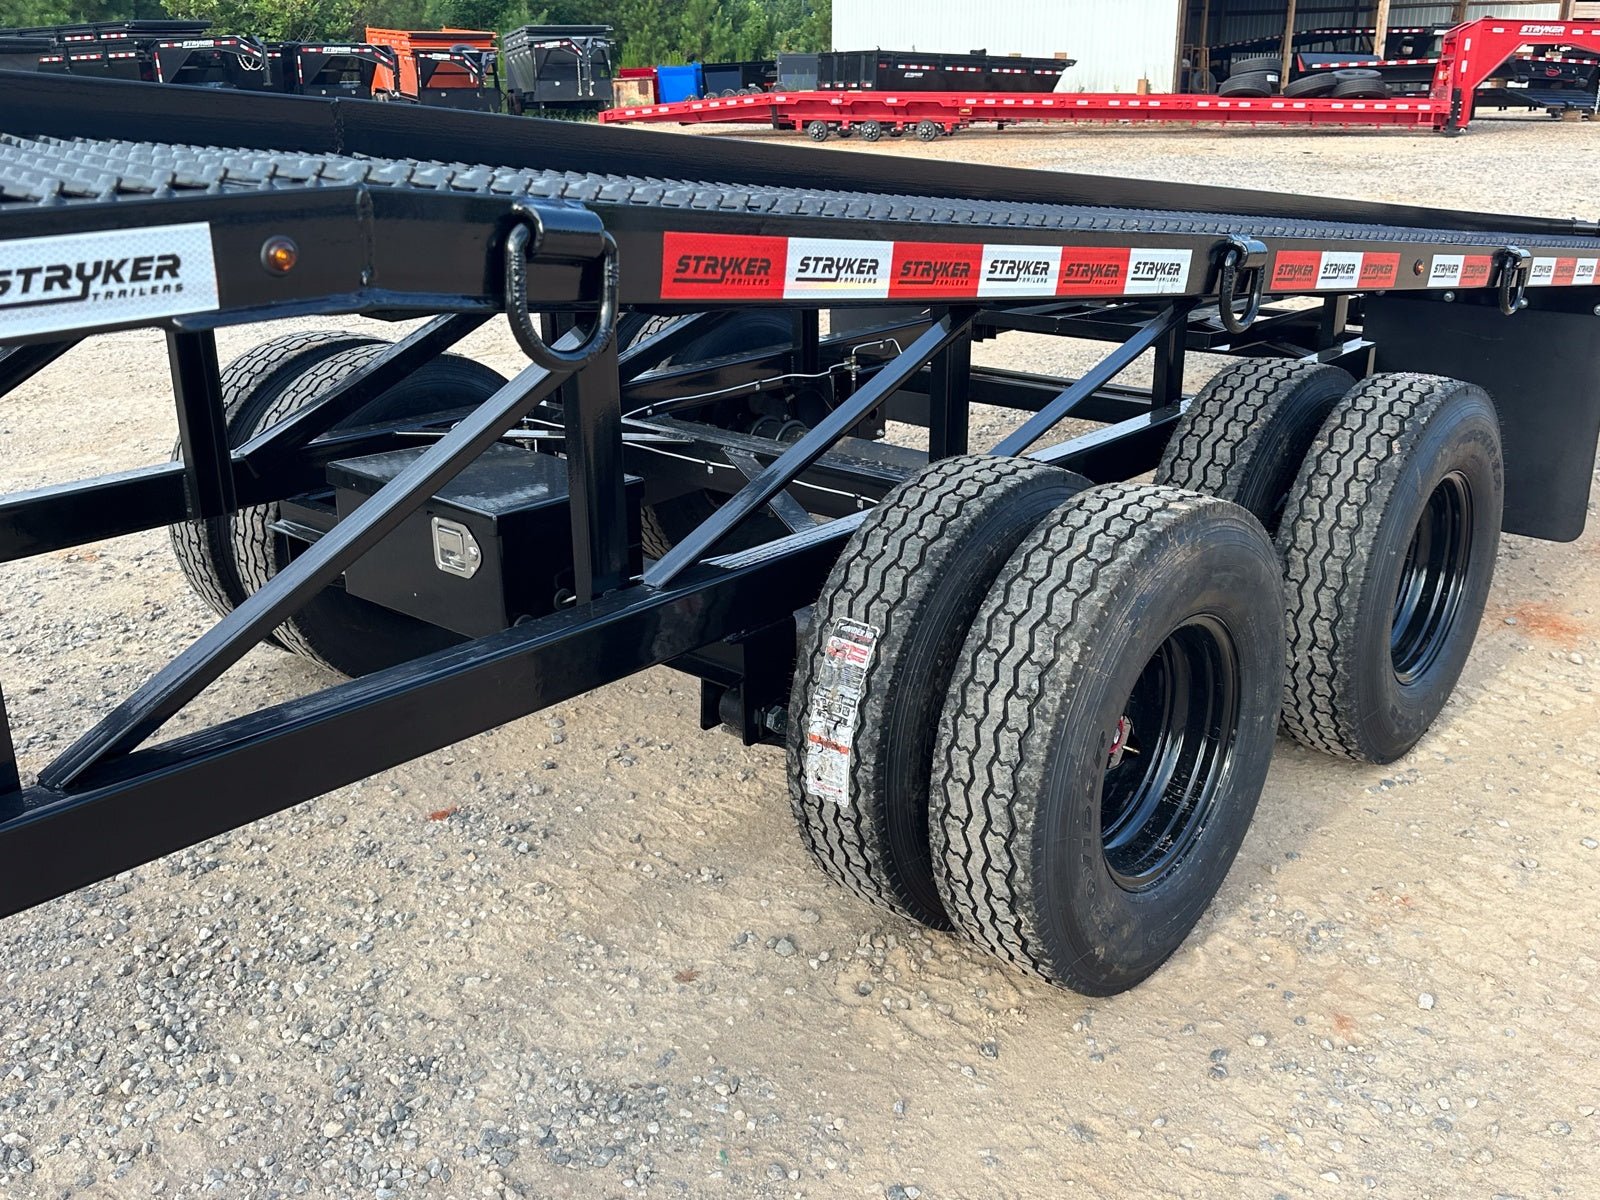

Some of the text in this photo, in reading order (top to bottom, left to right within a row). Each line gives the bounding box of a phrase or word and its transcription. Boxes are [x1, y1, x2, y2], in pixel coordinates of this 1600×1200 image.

[1520, 25, 1565, 35] STRYKER
[675, 255, 771, 282] STRYKER
[798, 256, 879, 281] STRYKER
[901, 261, 971, 284] STRYKER
[988, 260, 1050, 281] STRYKER
[1065, 263, 1119, 284] STRYKER
[1133, 262, 1181, 281] STRYKER
[1278, 264, 1313, 281] STRYKER
[1323, 263, 1355, 279] STRYKER
[1363, 264, 1392, 279] STRYKER
[1434, 264, 1458, 277] STRYKER
[725, 278, 770, 286] TRAILERS
[92, 283, 183, 301] TRAILERS
